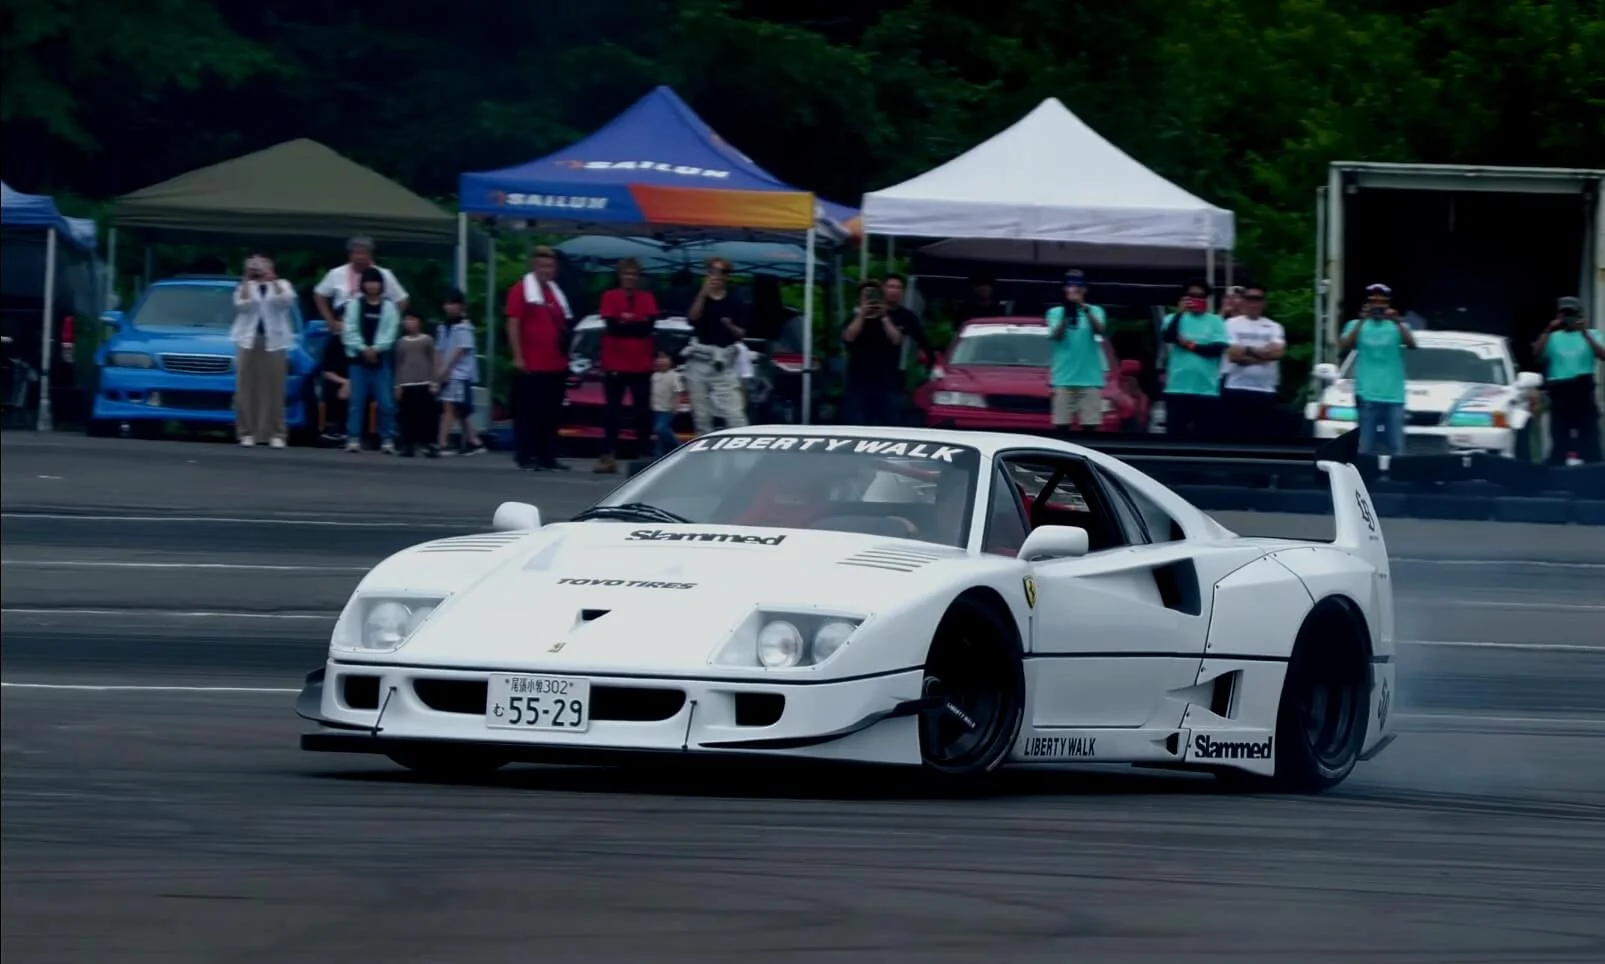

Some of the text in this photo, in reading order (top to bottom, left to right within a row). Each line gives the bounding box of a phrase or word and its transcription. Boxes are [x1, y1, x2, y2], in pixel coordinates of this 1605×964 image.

[584, 161, 730, 178] SAILUN
[689, 435, 966, 463] LIBERTY WALK
[625, 529, 788, 546] Slammed
[508, 696, 583, 727] 55-29
[1024, 736, 1096, 757] LIBERTY WALK
[1194, 734, 1273, 760] Slammed
